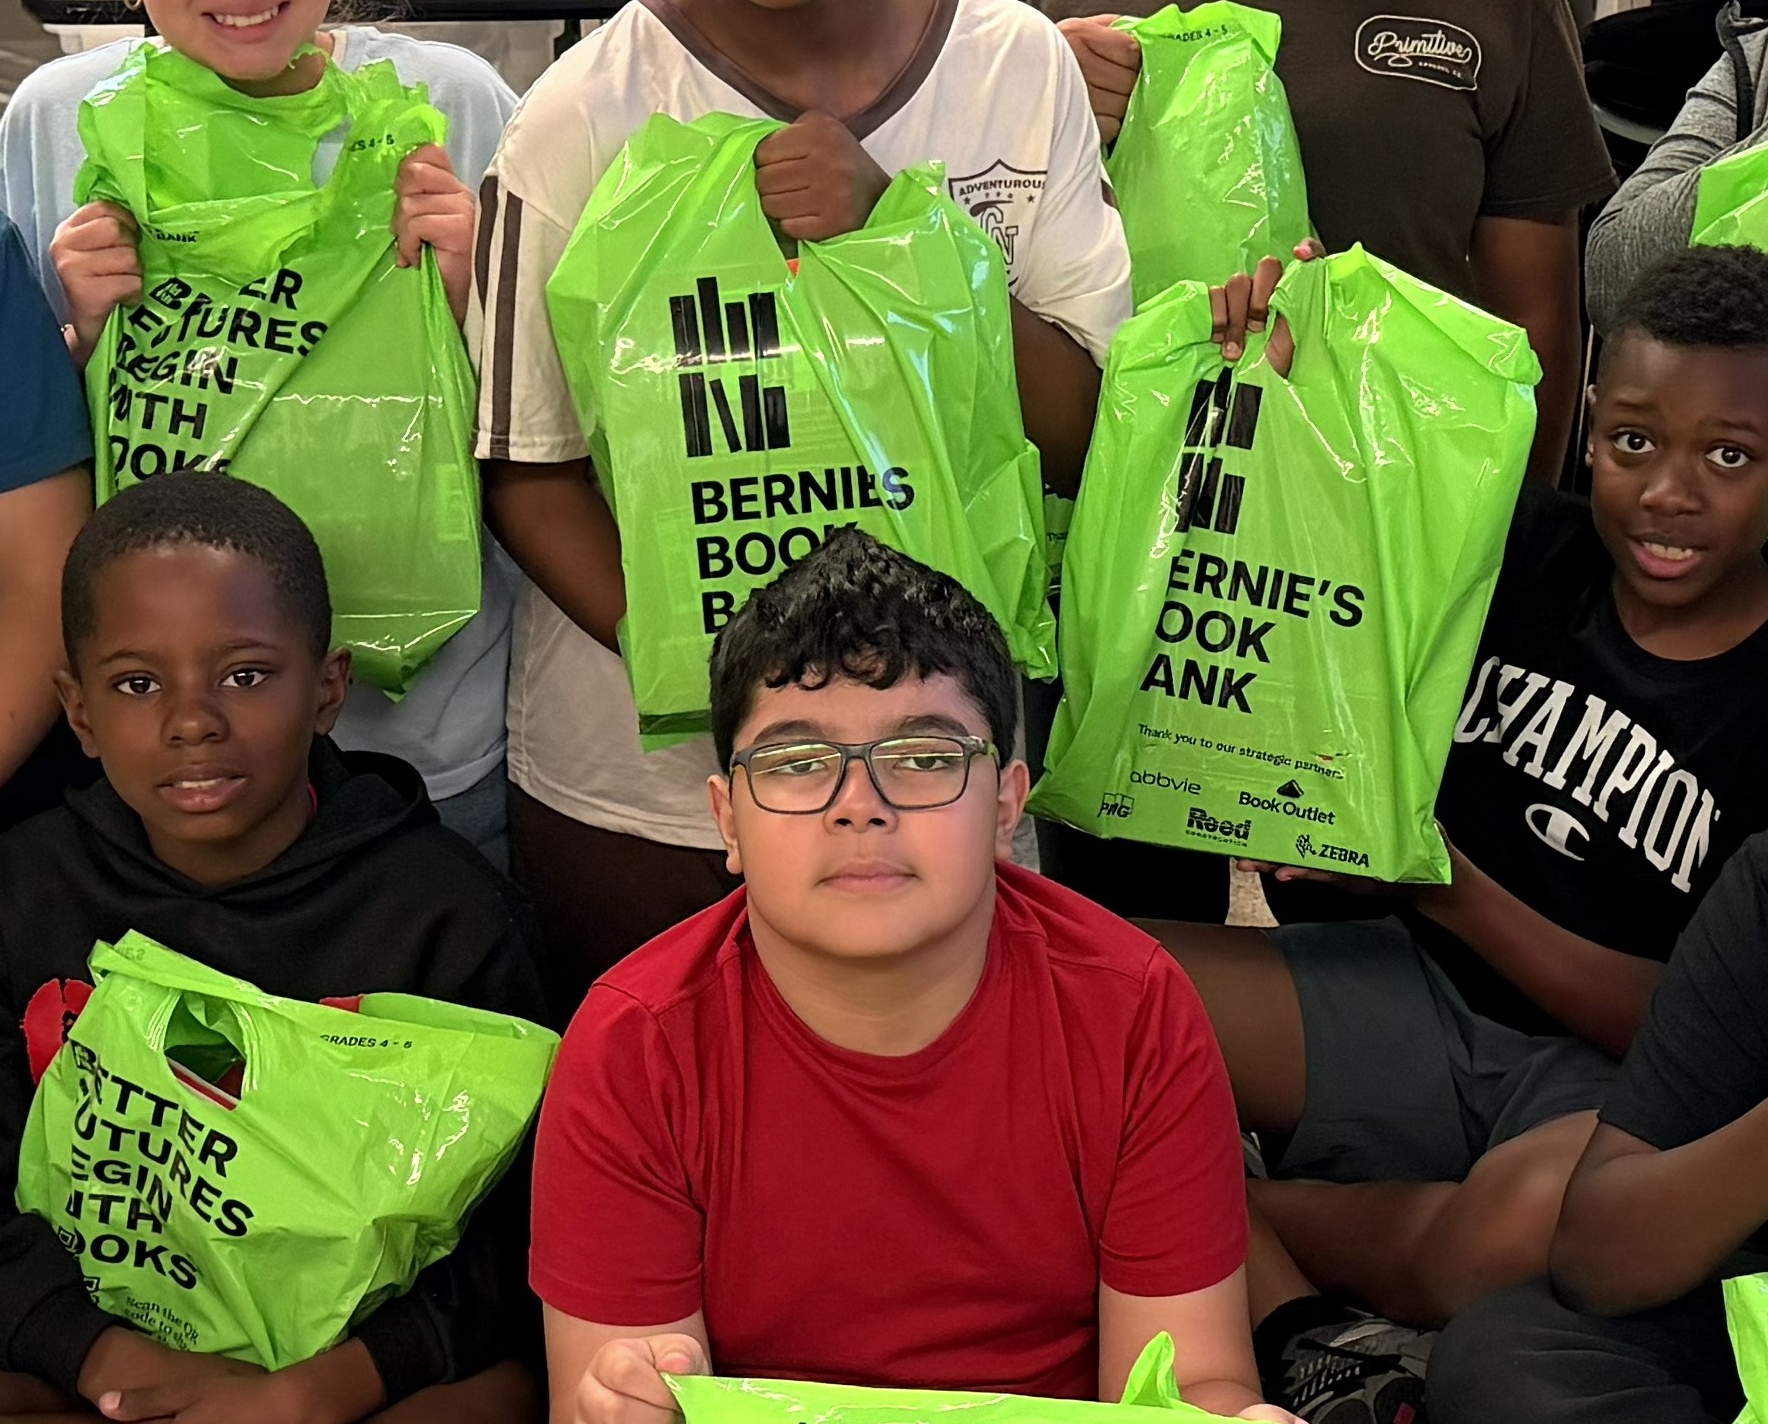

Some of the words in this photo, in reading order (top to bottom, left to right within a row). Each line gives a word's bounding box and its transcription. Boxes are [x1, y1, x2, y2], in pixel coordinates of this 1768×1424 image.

[1368, 29, 1472, 66] Primitive
[1129, 770, 1202, 795] abbvie
[1453, 656, 1720, 893] CHAMPION
[1239, 790, 1279, 815] Book
[1282, 797, 1336, 825] Outlet
[1320, 844, 1370, 868] ZEBRA
